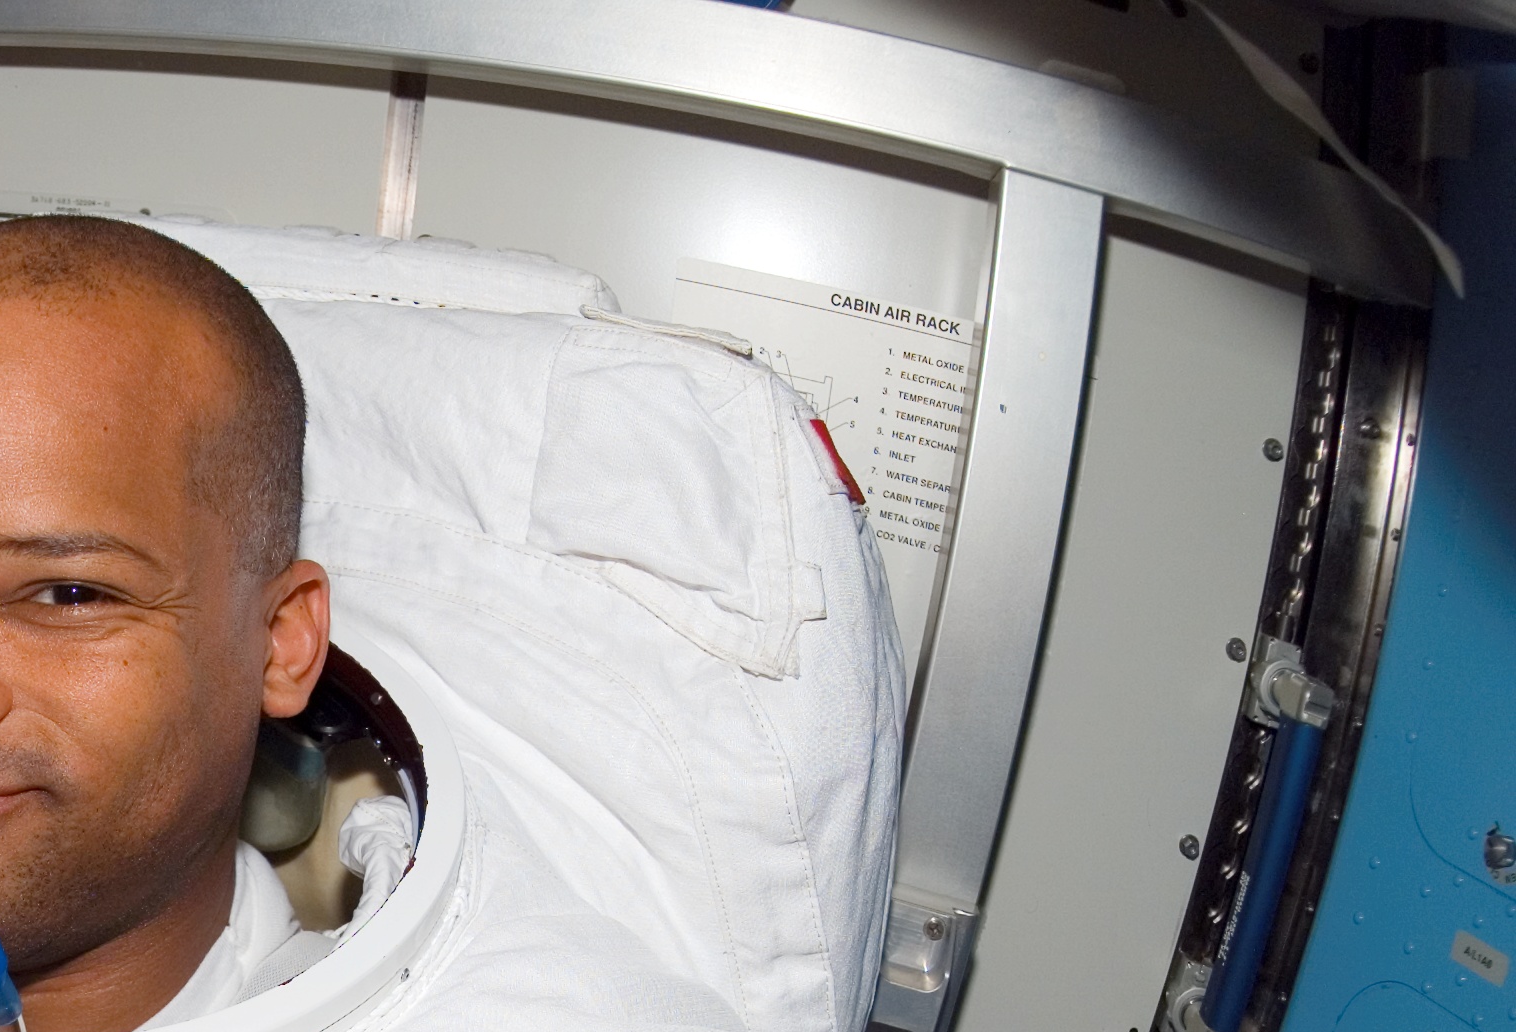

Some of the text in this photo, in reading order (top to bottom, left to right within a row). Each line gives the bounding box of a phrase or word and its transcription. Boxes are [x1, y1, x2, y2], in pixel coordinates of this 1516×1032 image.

[830, 293, 961, 336] CABIN AIR RACK
[902, 351, 933, 365] METAL
[936, 359, 964, 373] OXIDE
[900, 371, 957, 392] ELECTRICAL
[892, 430, 916, 443] HEAT
[889, 450, 916, 463] INLET
[886, 470, 919, 485] WATER
[883, 490, 912, 504] CABIN
[879, 510, 909, 524] METAL
[912, 518, 940, 532] OXIDE
[876, 529, 895, 541] CO2
[898, 535, 926, 550] VALVE
